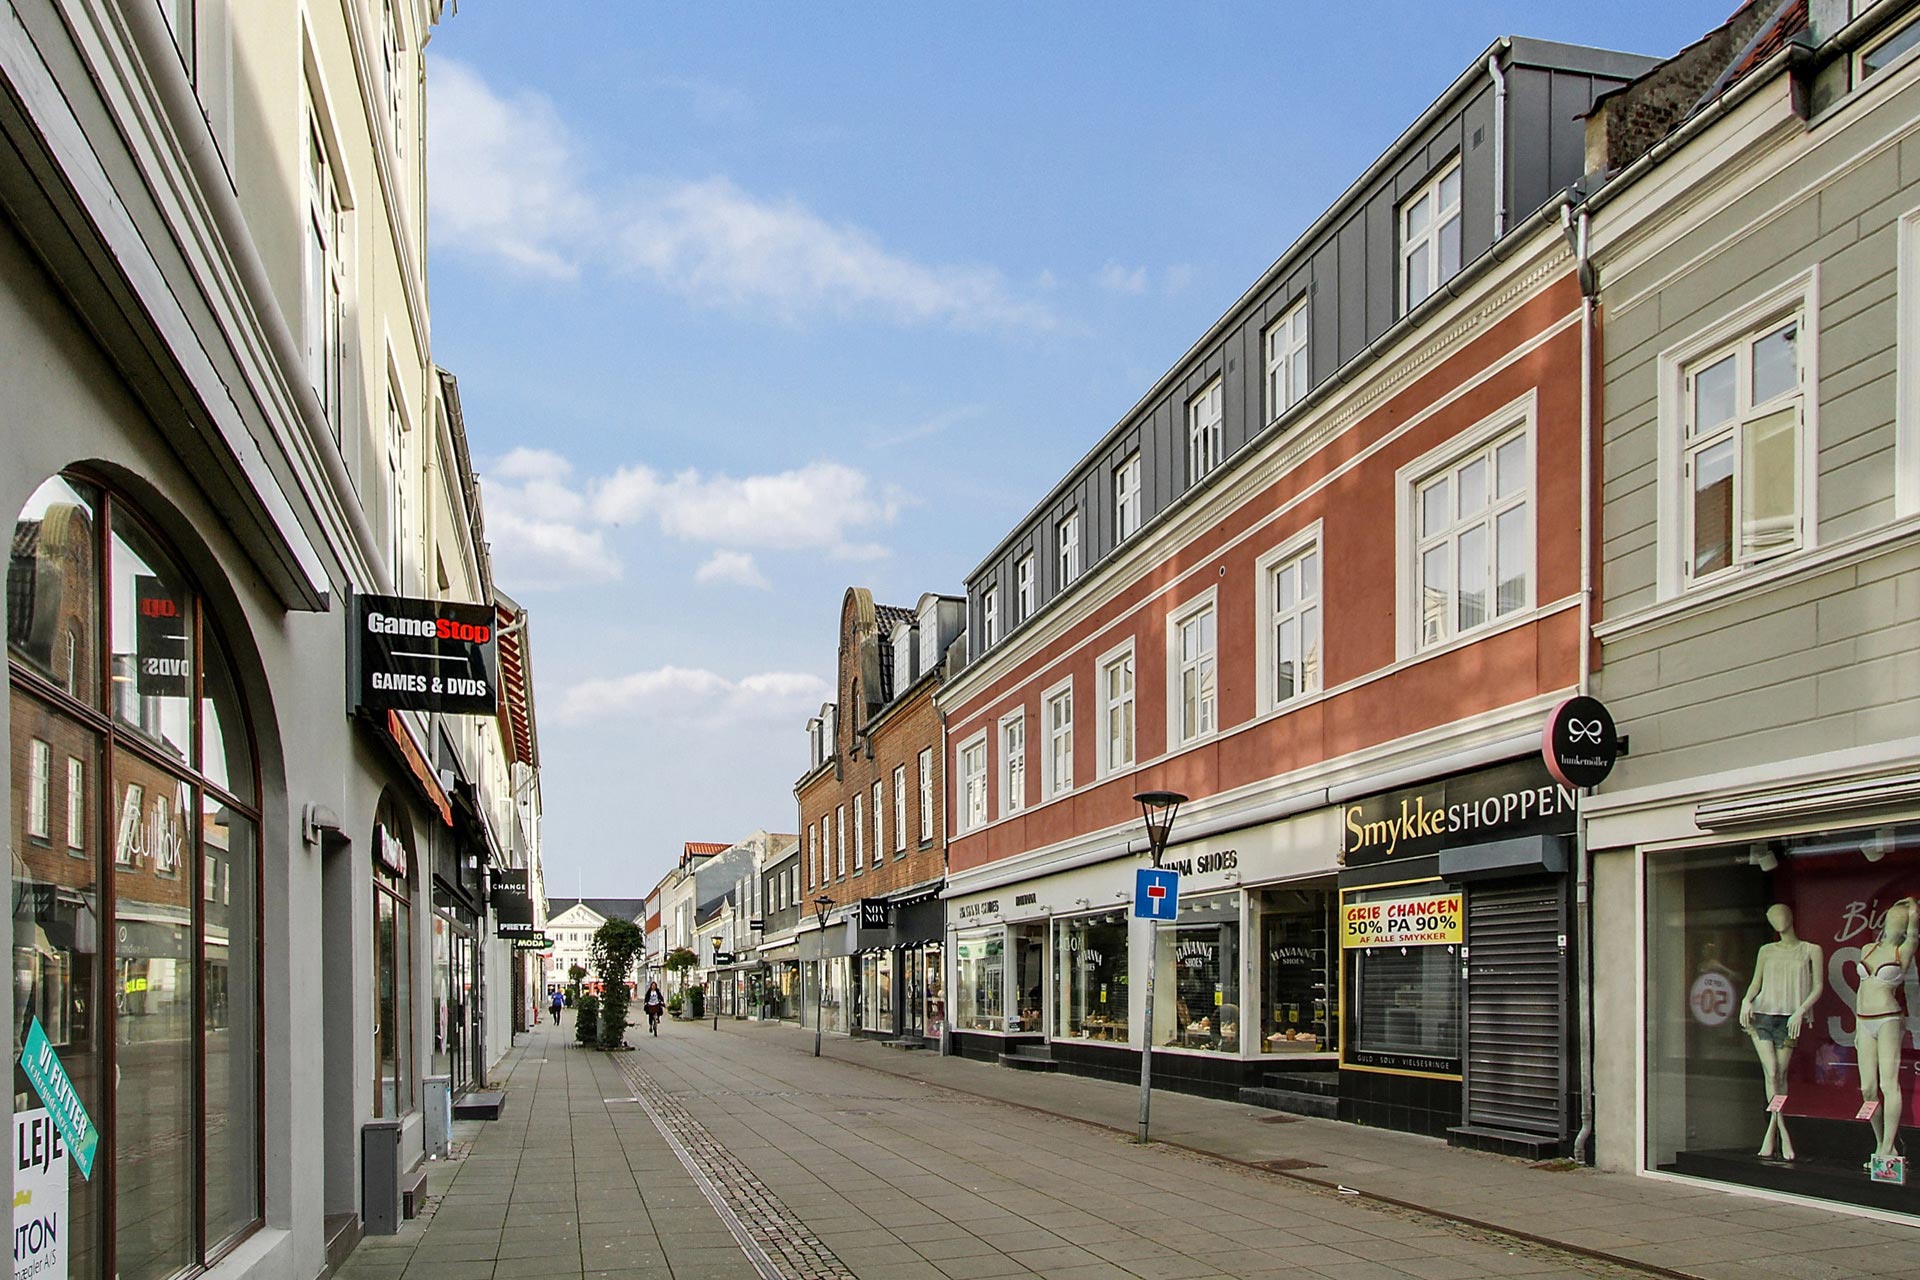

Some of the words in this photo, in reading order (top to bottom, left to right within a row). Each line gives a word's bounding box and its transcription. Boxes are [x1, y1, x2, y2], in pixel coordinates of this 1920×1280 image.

[368, 612, 490, 643] GameStop
[372, 672, 427, 692] GAMES
[431, 677, 443, 693] &
[447, 678, 486, 696] DVDS
[1561, 753, 1608, 767] hunkemöller
[1197, 850, 1238, 874] SHOES
[865, 905, 884, 914] NOA
[865, 914, 884, 923] NOA
[1347, 906, 1381, 921] GRIB
[1387, 899, 1459, 918] CHANCEN
[1348, 920, 1383, 935] 50%
[1416, 915, 1457, 931] 90%
[1360, 936, 1371, 944] AF
[1374, 935, 1395, 943] ALLE
[1399, 932, 1446, 942] SMYKKER
[1176, 941, 1213, 962] HAVANNA
[1271, 947, 1317, 961] HAVANNA
[1184, 957, 1203, 968] SHOES
[1357, 1054, 1374, 1063] GULD
[1402, 1058, 1450, 1071] VIELSESRINGE
[38, 1040, 52, 1074] VI
[50, 1063, 87, 1141] FLYTTER
[19, 1116, 63, 1175] LEJE
